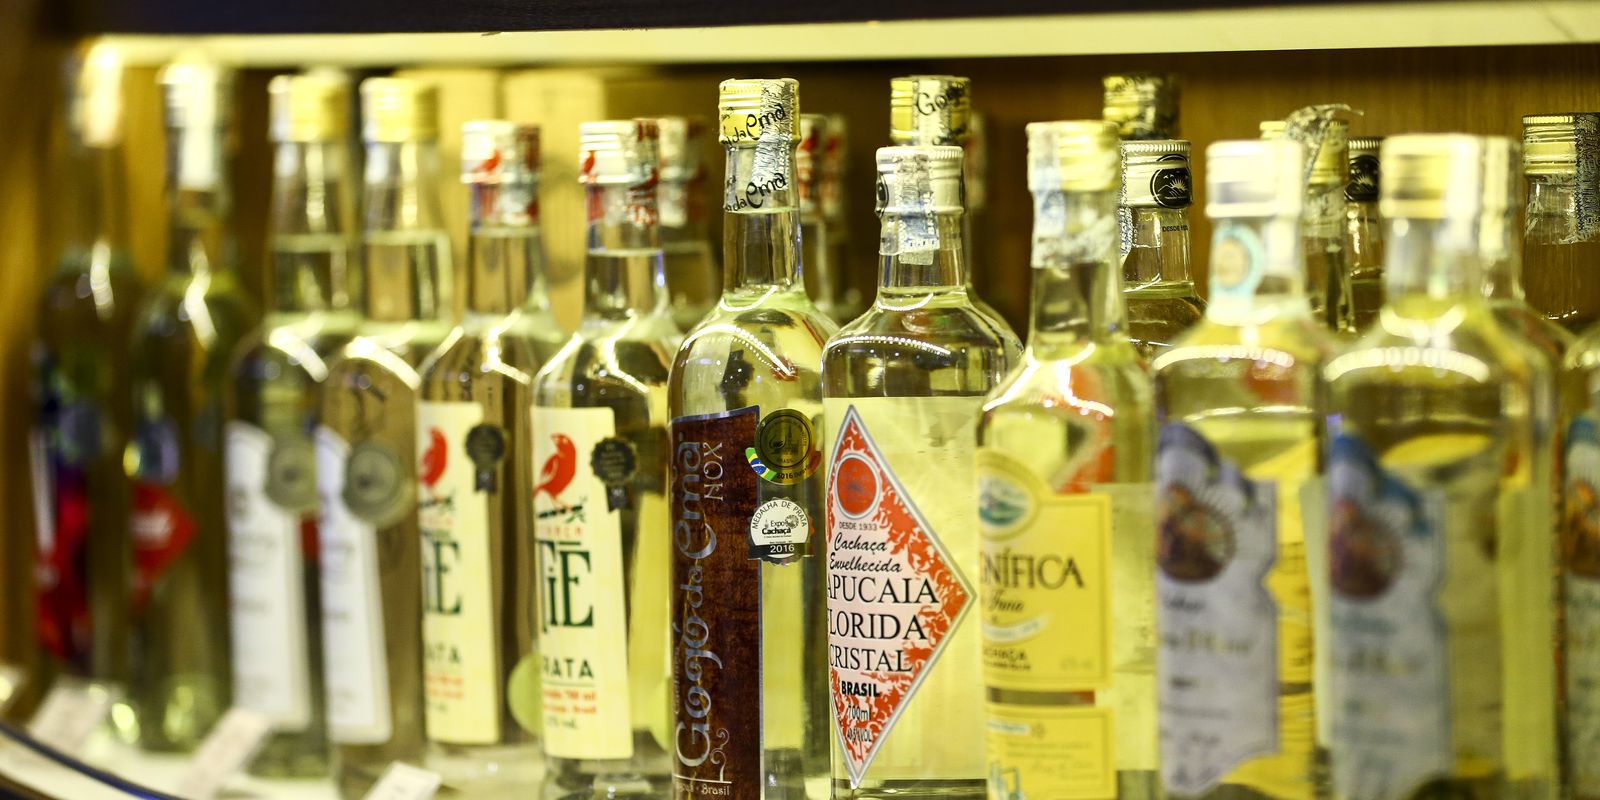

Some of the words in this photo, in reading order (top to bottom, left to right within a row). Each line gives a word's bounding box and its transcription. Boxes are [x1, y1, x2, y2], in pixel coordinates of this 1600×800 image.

[751, 501, 779, 530] MEDALHA
[781, 500, 792, 509] DE
[792, 506, 808, 527] PRATA
[770, 520, 787, 528] Expo
[838, 521, 857, 531] DESDE
[859, 523, 878, 532] 1933
[769, 544, 795, 553] 2016
[833, 532, 888, 556] Cachaça
[829, 552, 902, 574] Envelhecida
[679, 565, 704, 609] da
[826, 608, 927, 640] LORIDA
[841, 680, 881, 698] BRASIL
[702, 783, 730, 796] Brasil
